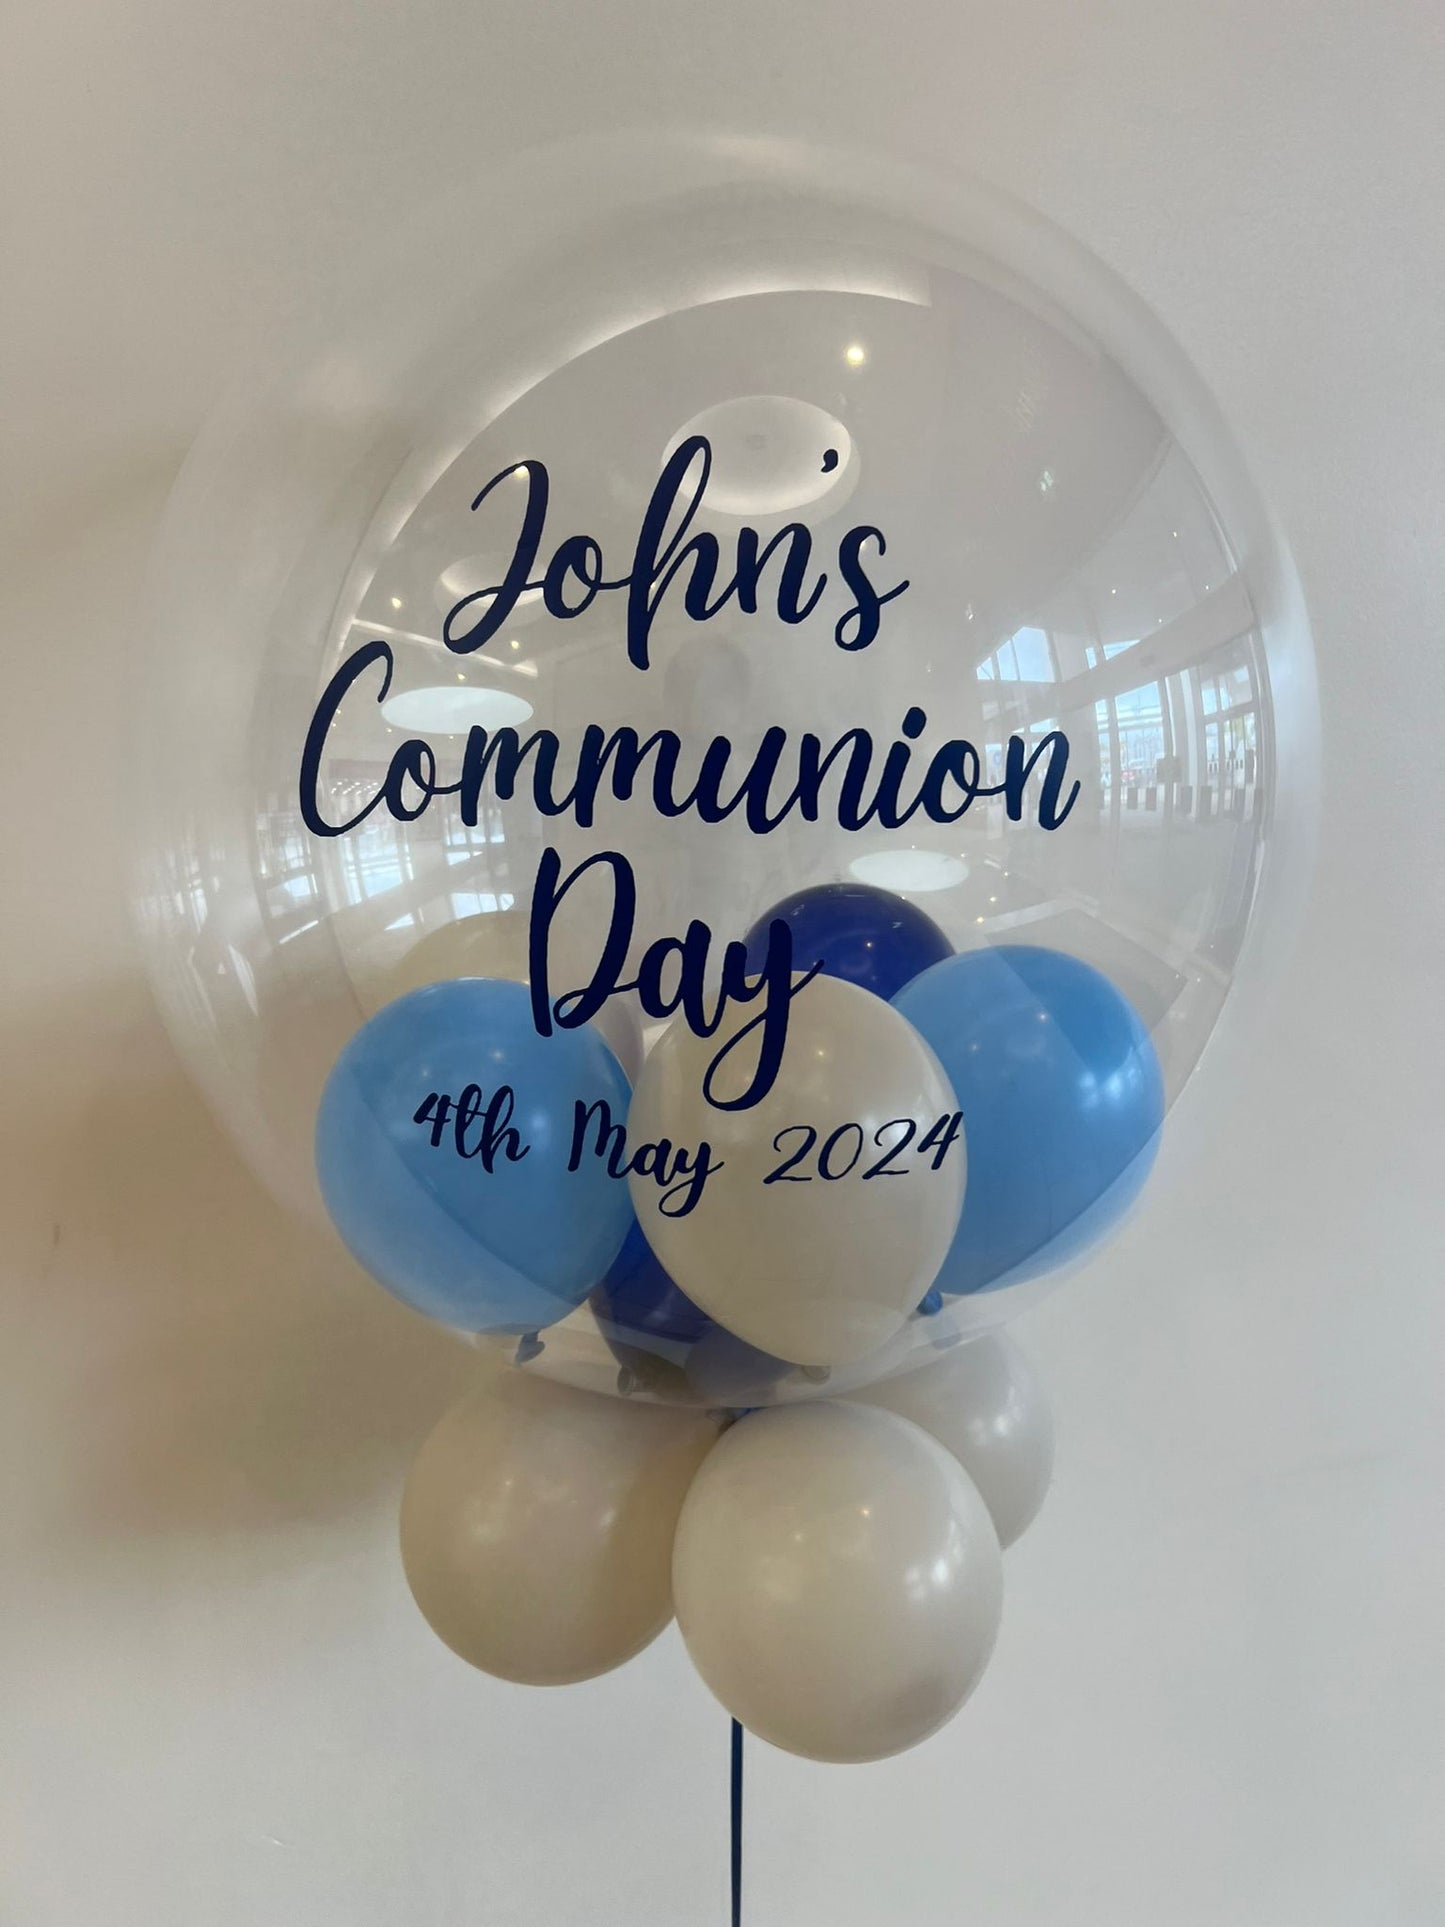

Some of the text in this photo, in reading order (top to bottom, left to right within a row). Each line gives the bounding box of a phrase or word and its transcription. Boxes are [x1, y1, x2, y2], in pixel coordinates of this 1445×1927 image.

[443, 435, 910, 671] John's
[299, 640, 1081, 838] Communion
[529, 847, 822, 1111] Day
[412, 1084, 964, 1218] 4th May 2024
